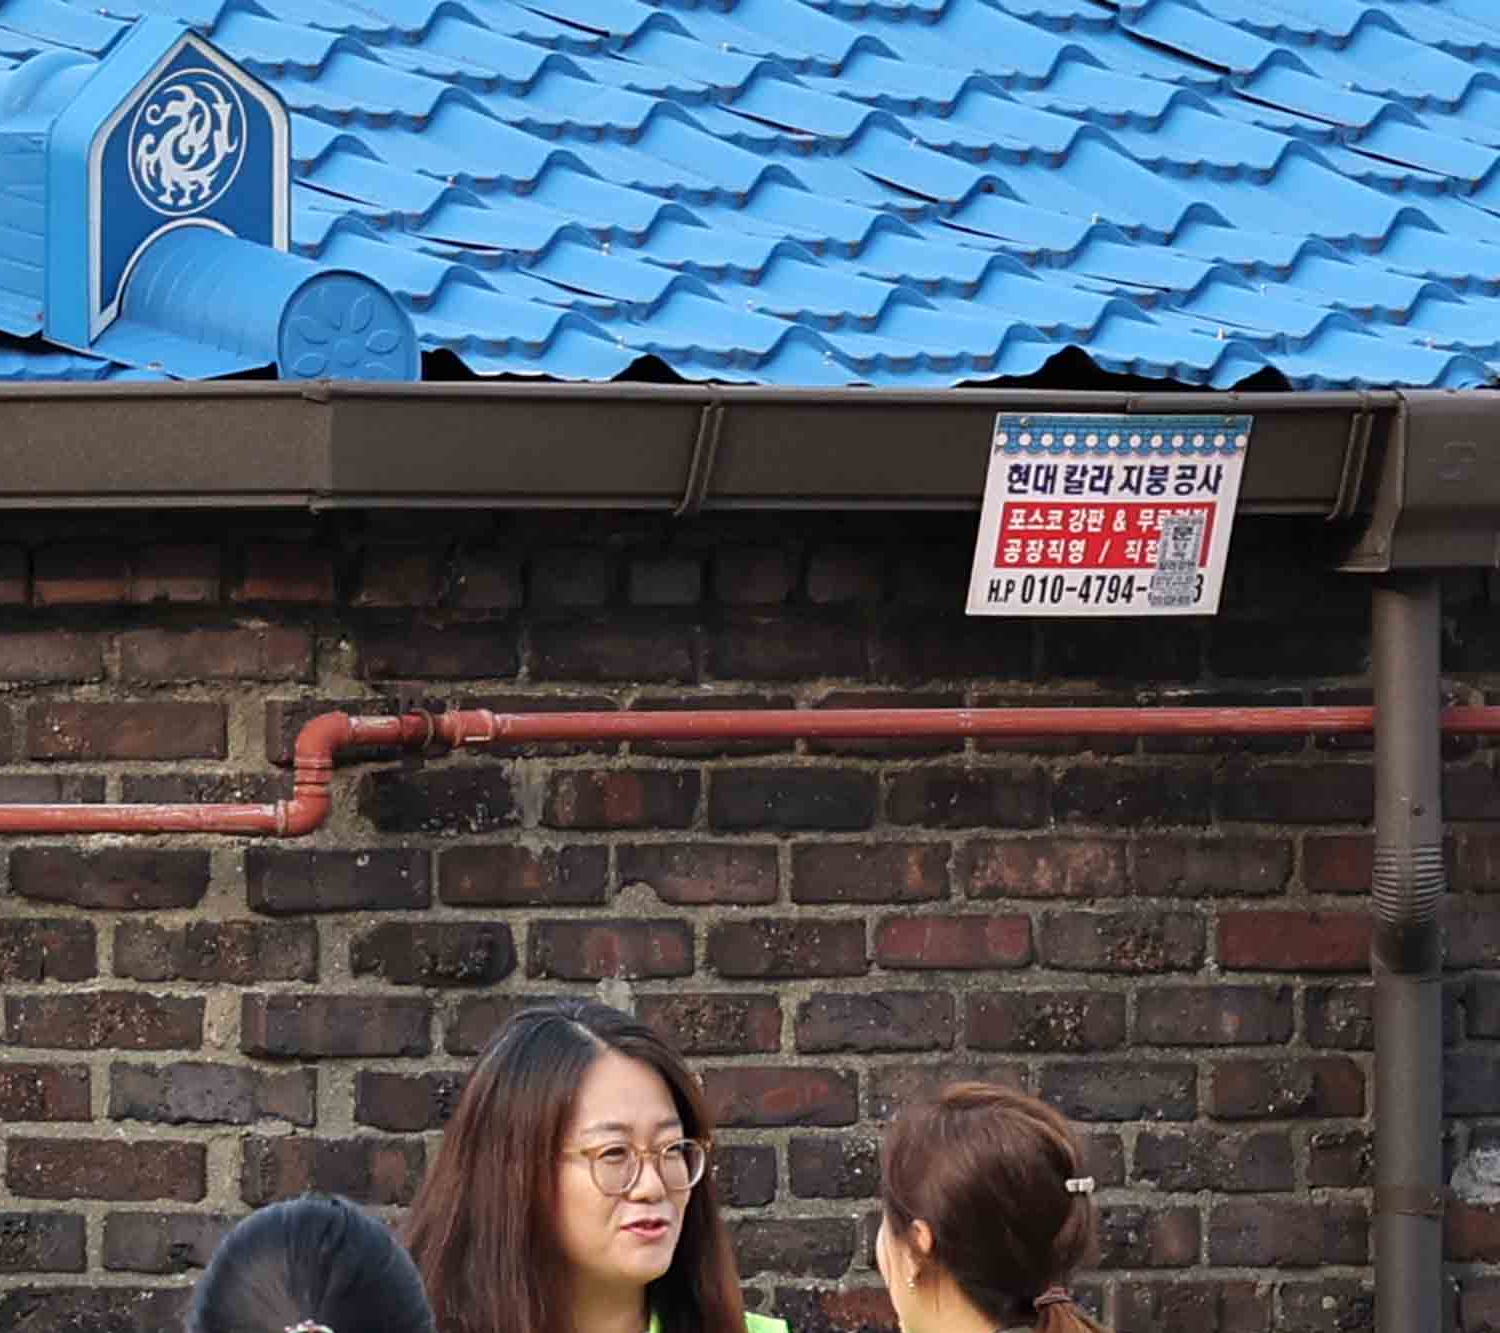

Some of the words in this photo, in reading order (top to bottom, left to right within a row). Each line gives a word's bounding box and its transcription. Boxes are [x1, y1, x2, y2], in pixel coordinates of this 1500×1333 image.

[1007, 464, 1057, 494] 현대
[1064, 464, 1114, 495] 칼라
[1118, 464, 1168, 495] 지붕
[1175, 464, 1223, 496] 공사
[1007, 509, 1063, 531] 포스코
[1068, 509, 1104, 533] 강판
[1112, 510, 1127, 532] &
[1136, 509, 1209, 533] 무료
[1003, 538, 1086, 564] 공장직영
[988, 578, 1015, 603] H.P
